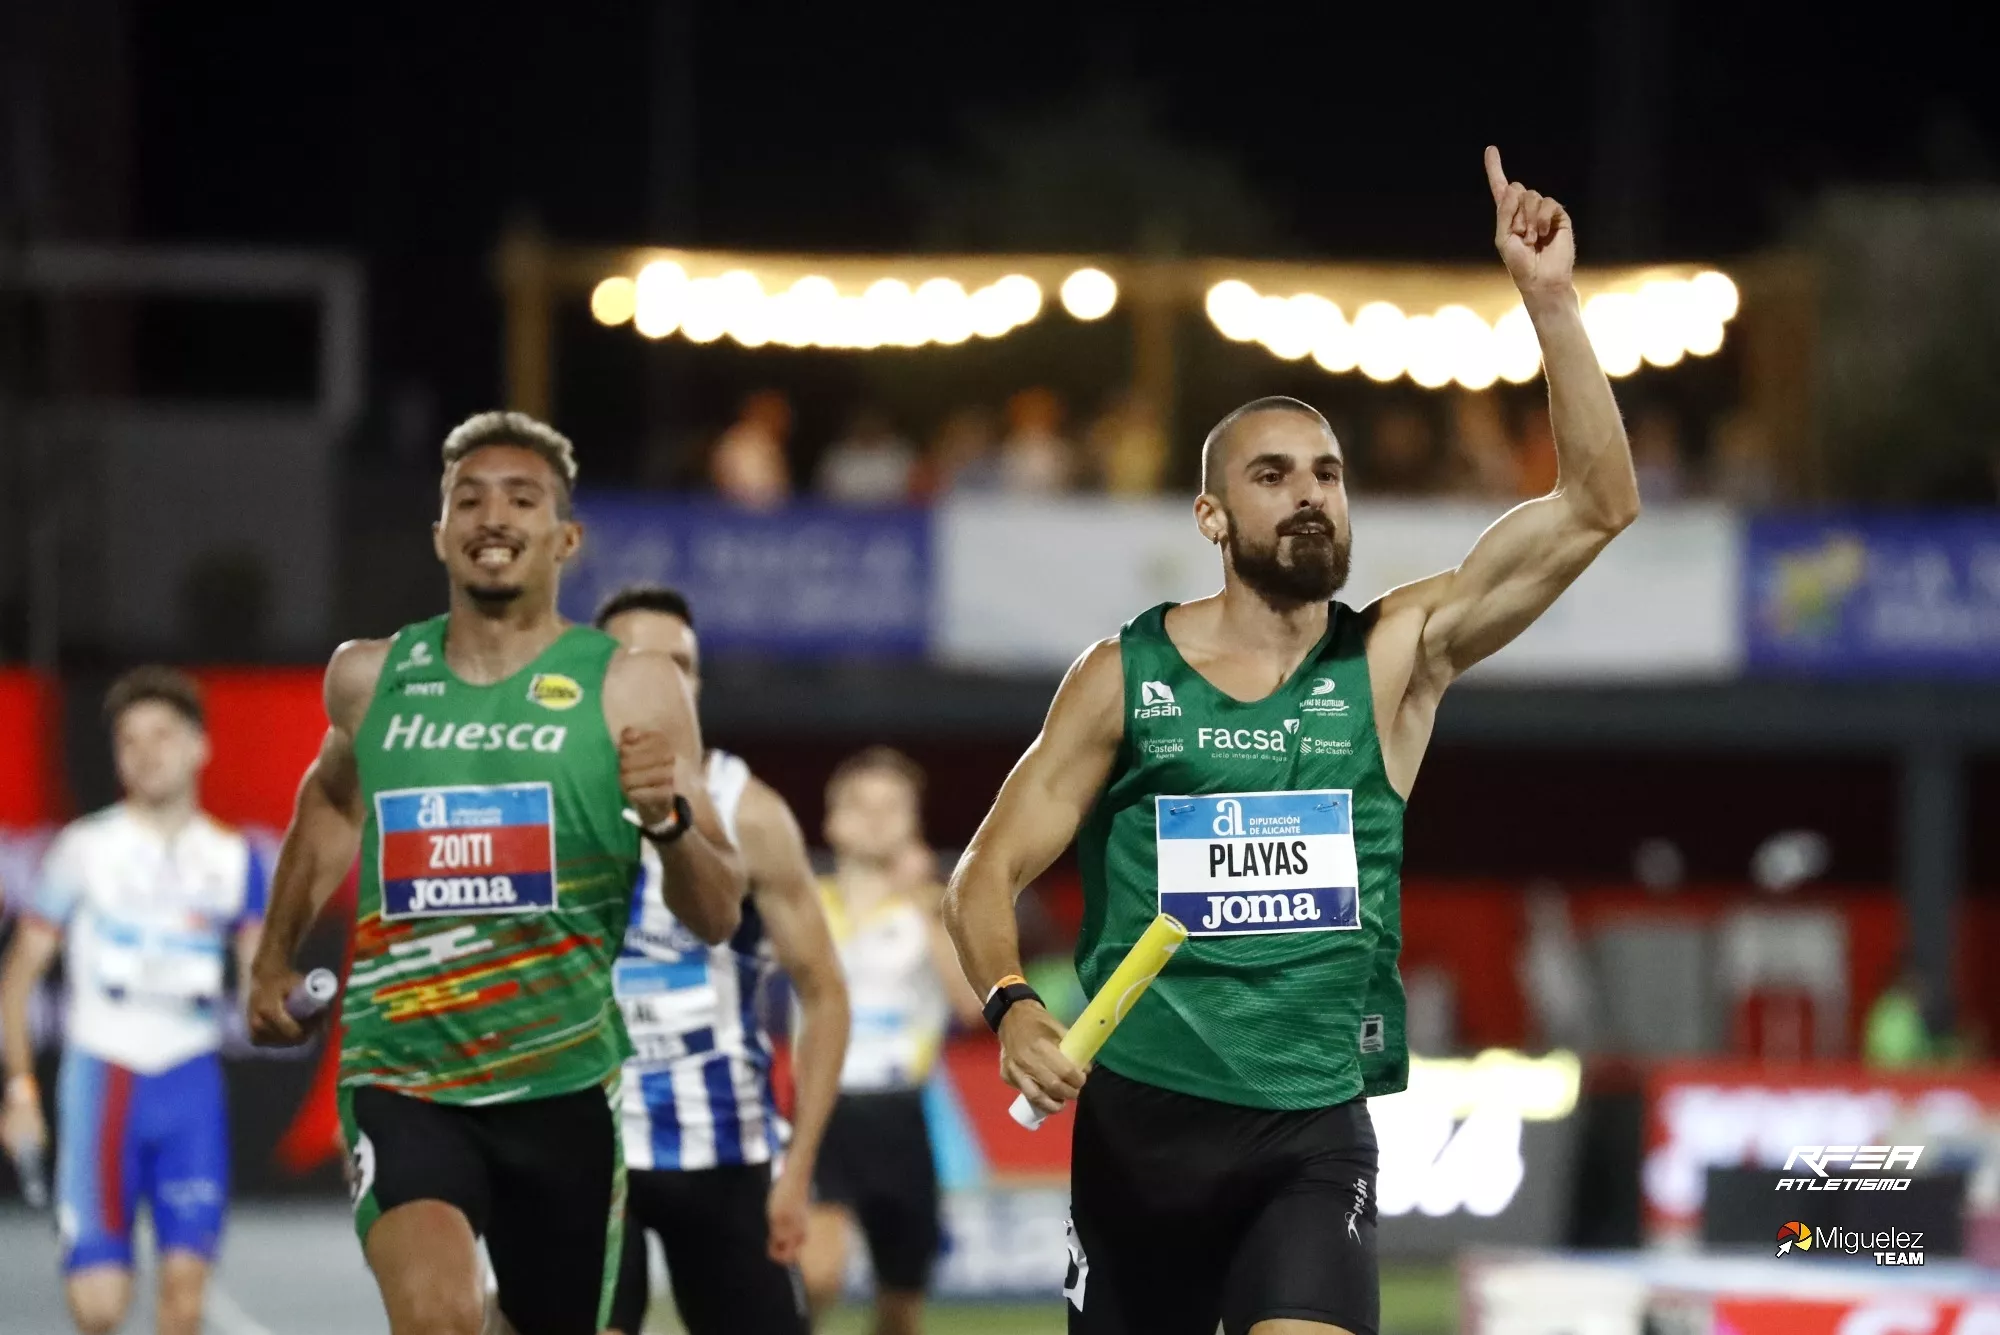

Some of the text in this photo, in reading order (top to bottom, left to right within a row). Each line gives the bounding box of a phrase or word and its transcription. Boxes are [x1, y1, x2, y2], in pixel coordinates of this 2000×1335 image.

[382, 713, 568, 754] Huesca
[1198, 727, 1287, 752] Facsa
[1314, 739, 1352, 748] Diputació
[1148, 743, 1184, 753] Castelló
[1232, 752, 1259, 760] integral
[1250, 815, 1300, 826] DIPUTACIÓN
[1250, 825, 1301, 835] DE ALICANTE
[429, 832, 493, 869] ZOITI
[1209, 840, 1308, 878] PLAYAS
